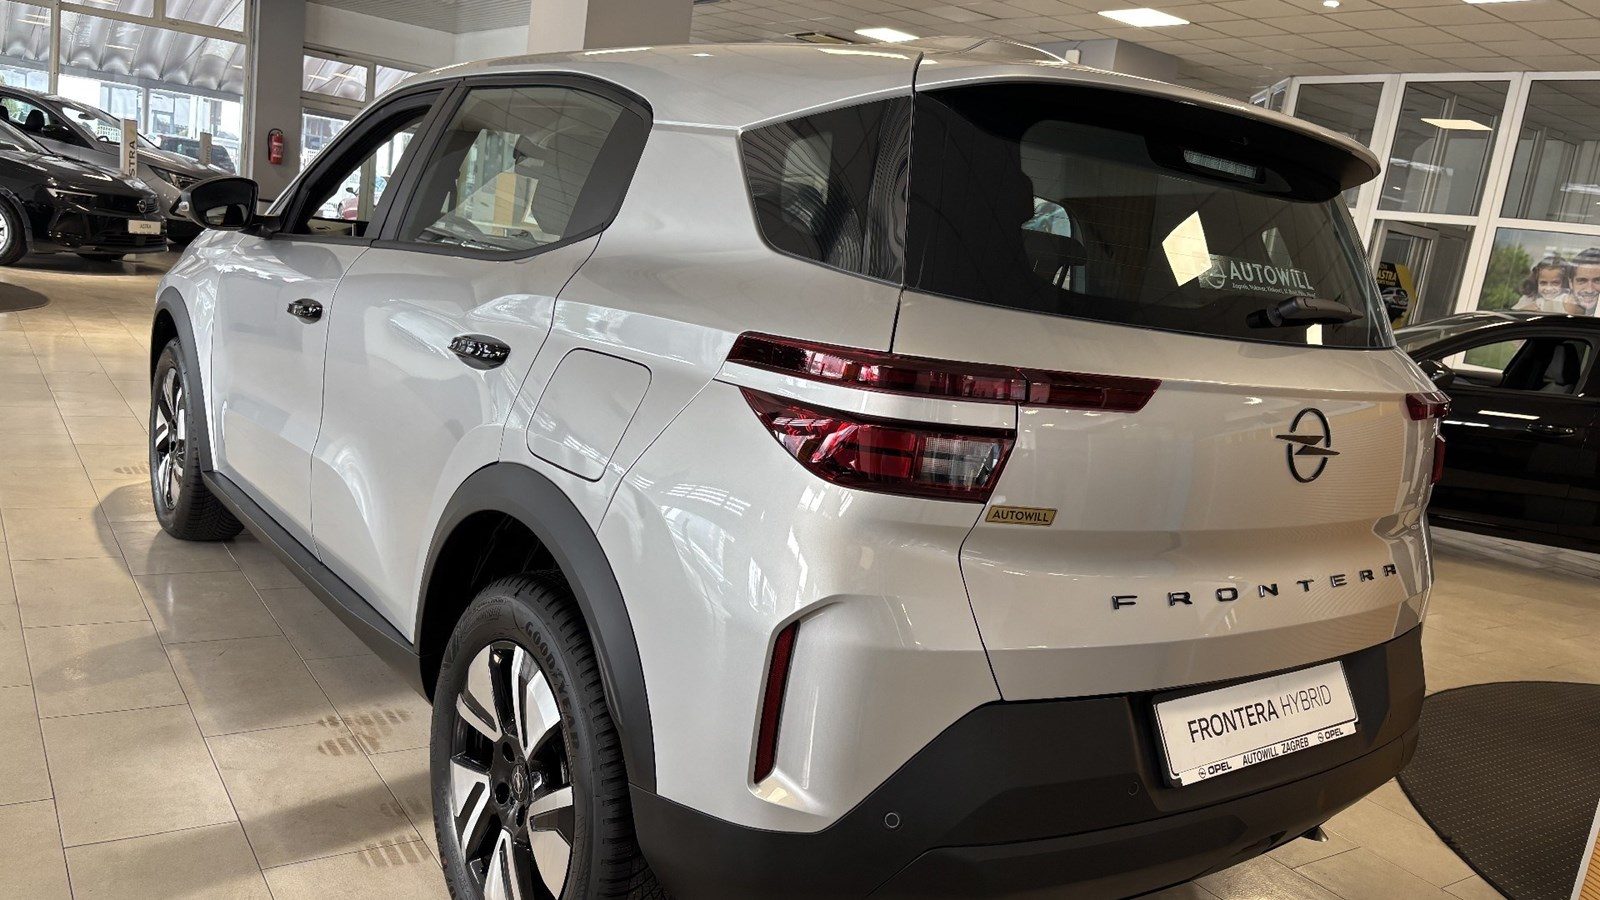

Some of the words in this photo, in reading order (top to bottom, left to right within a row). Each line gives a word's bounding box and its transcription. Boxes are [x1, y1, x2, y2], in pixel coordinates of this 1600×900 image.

[128, 140, 136, 177] STRA
[1230, 260, 1315, 291] AUTOWILL
[992, 509, 1049, 522] AUTOWILL
[1187, 699, 1280, 744] FRONTERA
[1279, 684, 1332, 717] HYBRID
[1207, 761, 1233, 776] OPEL
[1242, 746, 1280, 767] AUTOWILL
[1280, 736, 1310, 754] ZAGREB
[1324, 727, 1344, 741] OPEL
